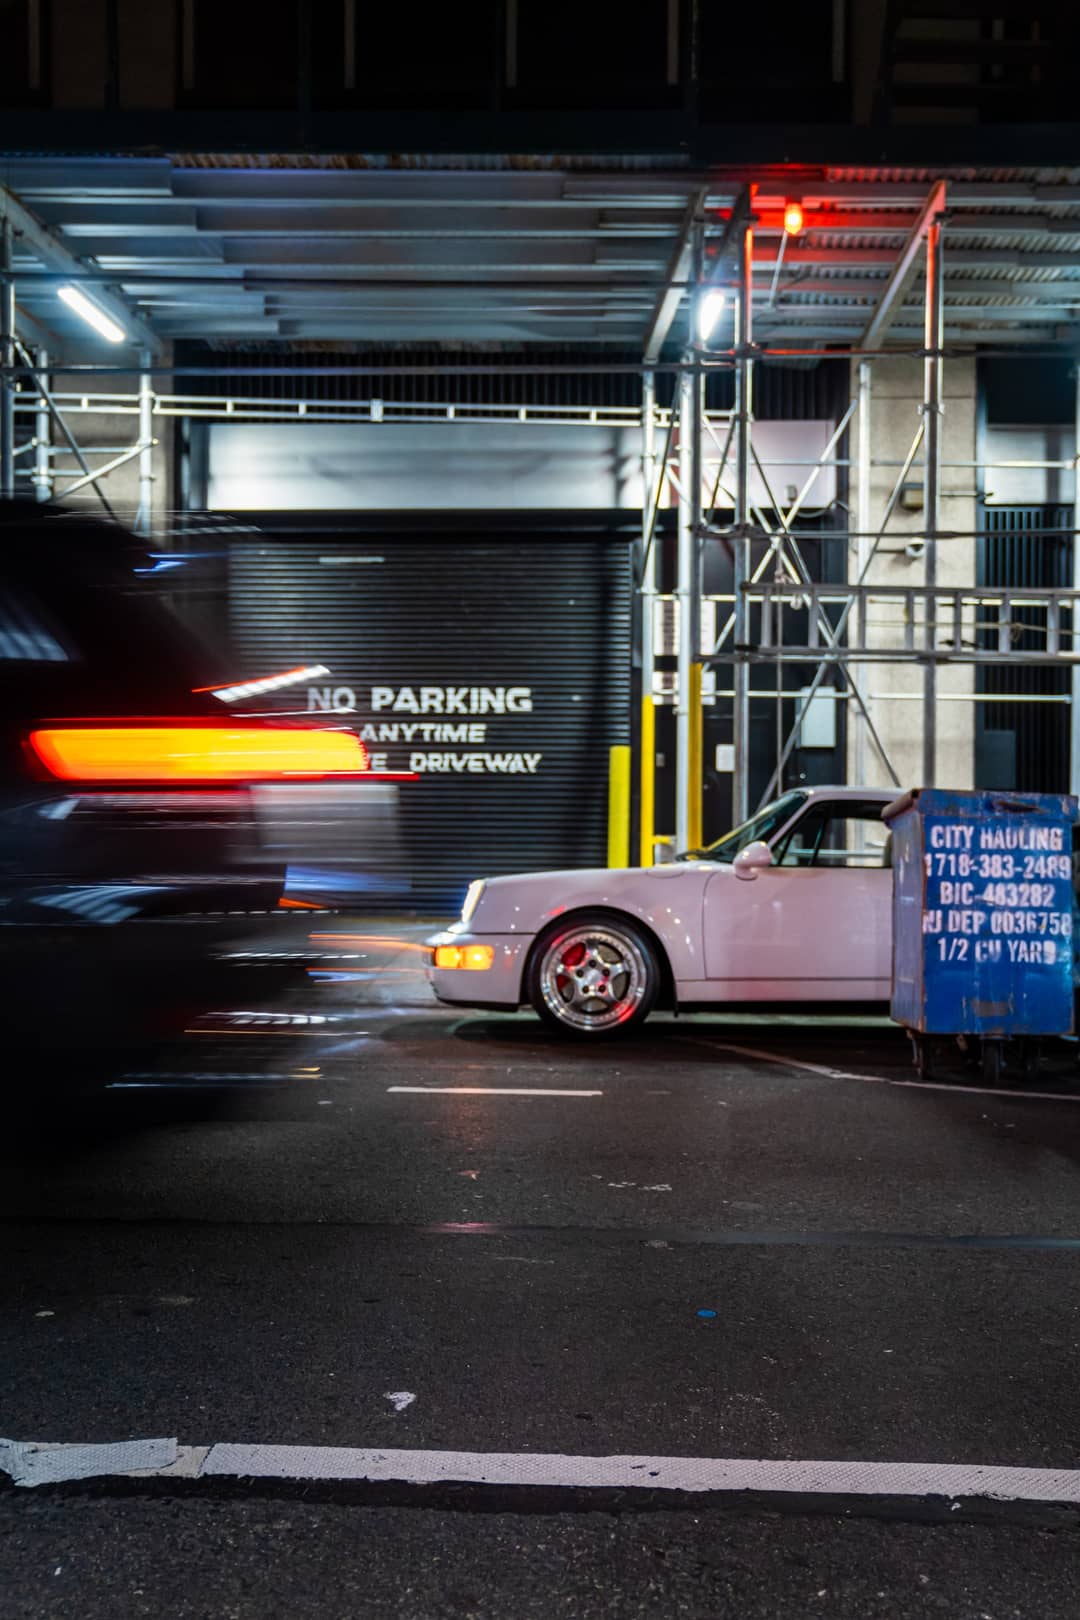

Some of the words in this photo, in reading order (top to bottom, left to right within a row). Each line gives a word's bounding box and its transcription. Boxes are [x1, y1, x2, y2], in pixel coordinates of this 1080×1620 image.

[307, 687, 356, 711] NO
[371, 687, 532, 713] PARKING
[360, 724, 486, 742] ANYTIME
[410, 753, 541, 773] DRIVEWAY
[930, 825, 974, 849] CITY
[980, 826, 1064, 851] HAULING
[948, 910, 986, 935] DEP
[938, 938, 968, 961] 1/2
[1008, 940, 1056, 965] YARD
